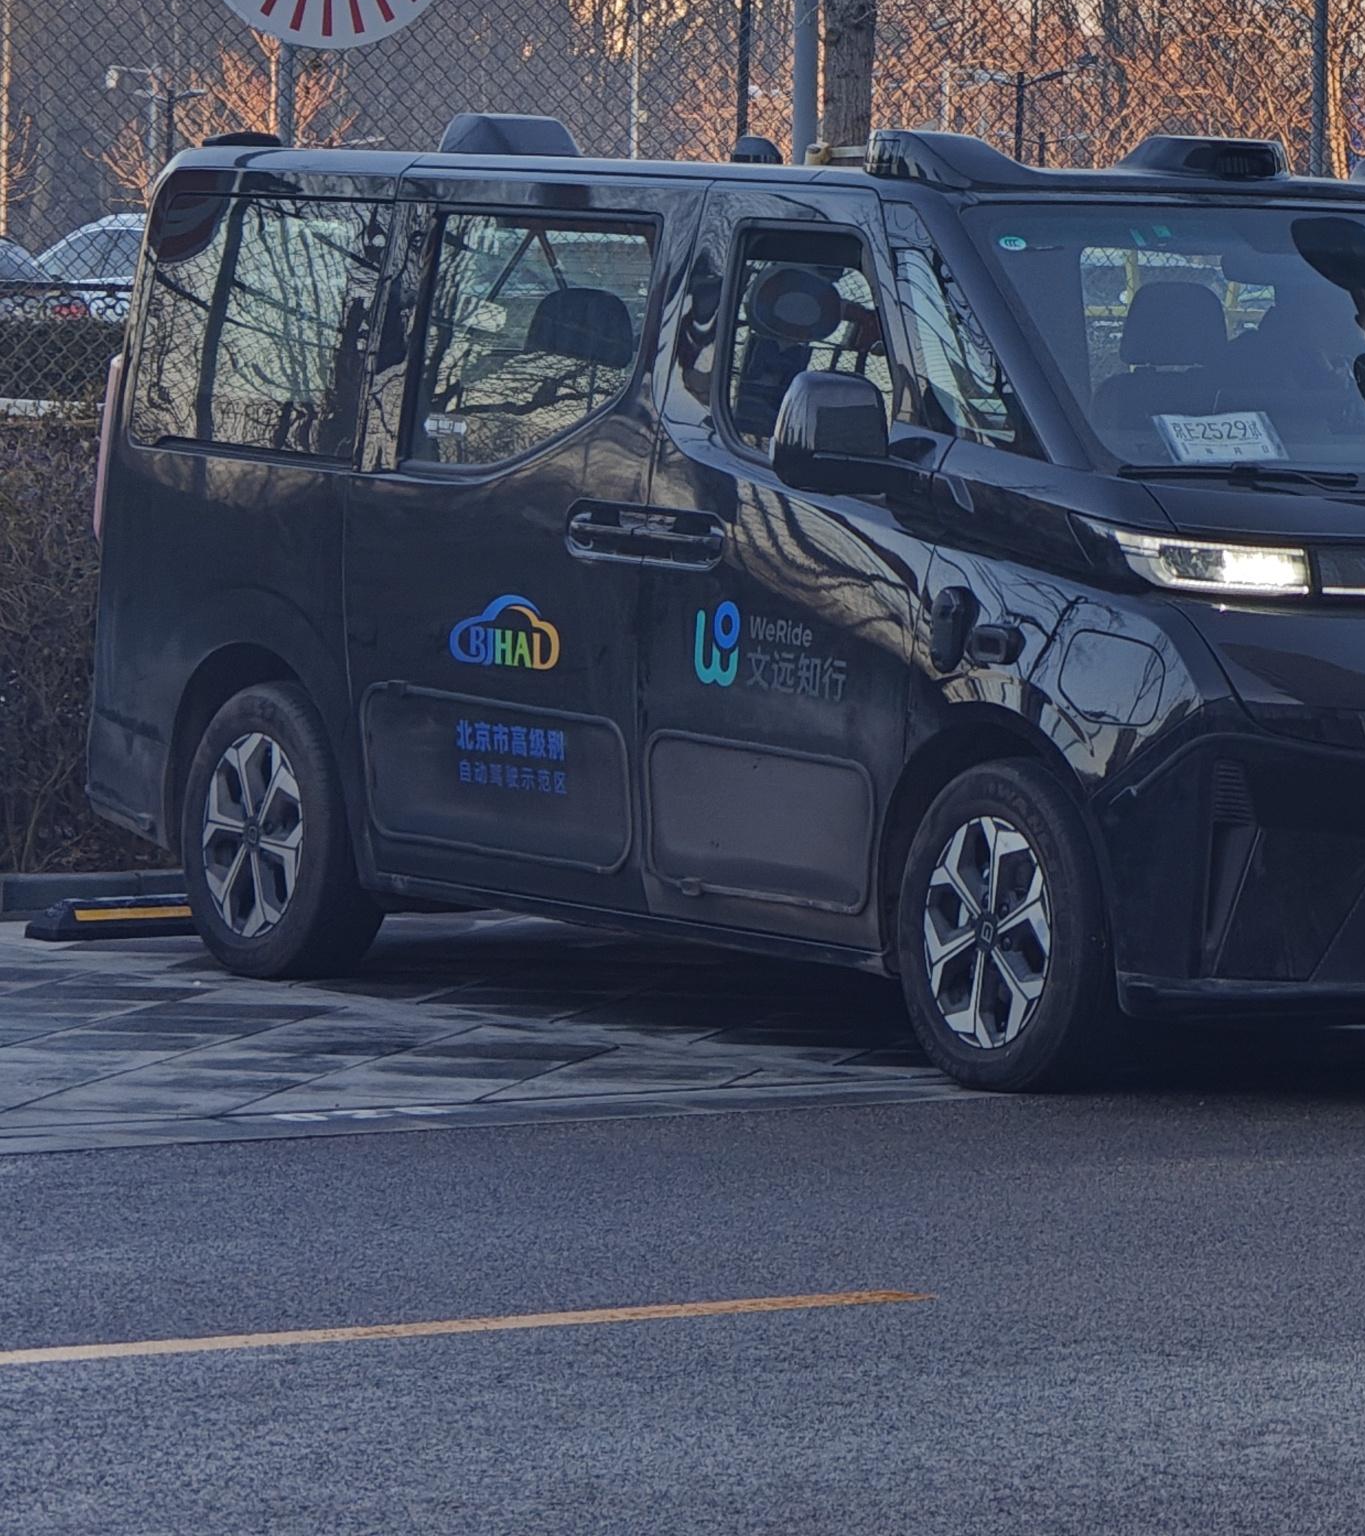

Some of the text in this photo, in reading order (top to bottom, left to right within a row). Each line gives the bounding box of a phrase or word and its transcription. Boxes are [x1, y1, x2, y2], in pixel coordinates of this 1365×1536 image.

[750, 614, 813, 648] WeRide
[746, 646, 848, 703] 文远知行
[456, 718, 566, 763] 北京市高级别
[457, 758, 568, 795] 自动驾驶示范区
